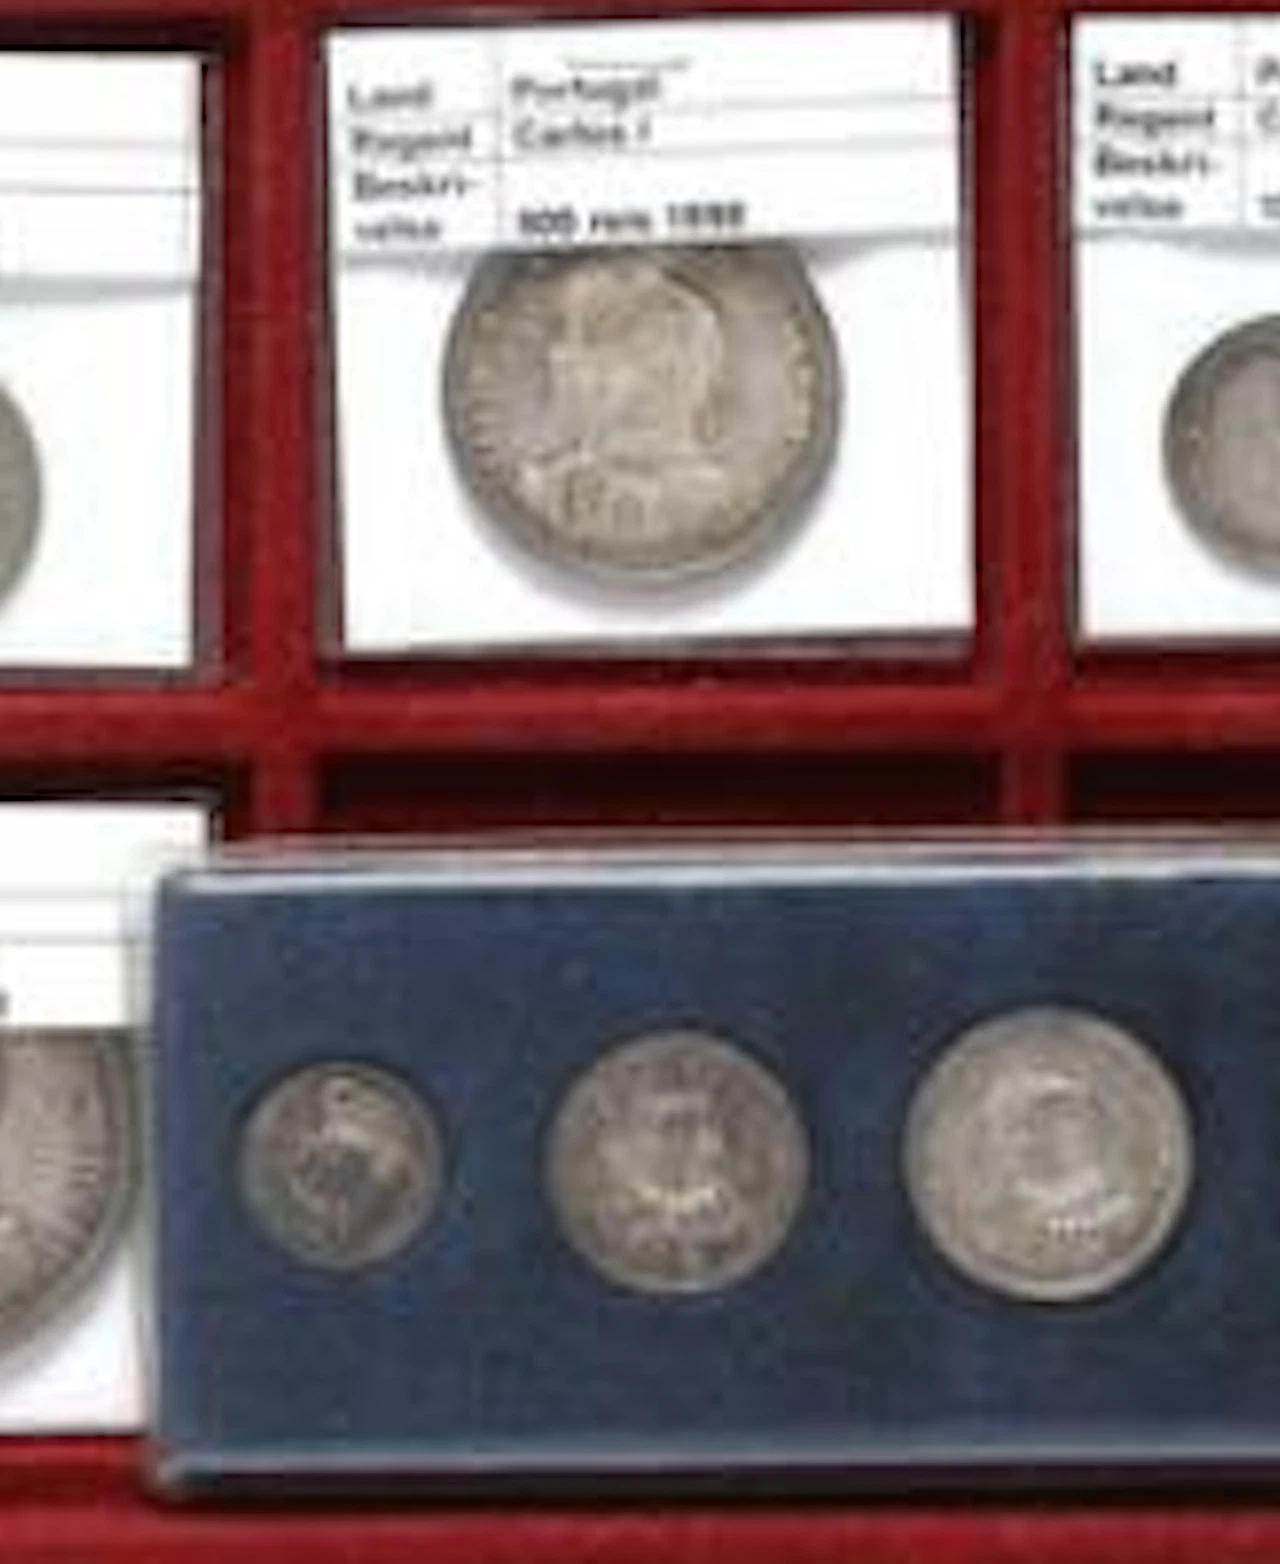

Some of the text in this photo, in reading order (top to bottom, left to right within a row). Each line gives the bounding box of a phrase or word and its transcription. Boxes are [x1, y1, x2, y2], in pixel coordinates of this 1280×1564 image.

[1091, 60, 1179, 90] Land
[345, 83, 434, 114] Land
[509, 74, 661, 114] Portugal
[512, 117, 628, 152] Carlos
[1092, 99, 1217, 142] Regent
[349, 124, 474, 165] Regent
[1093, 192, 1184, 221] velse
[354, 215, 442, 244] velse
